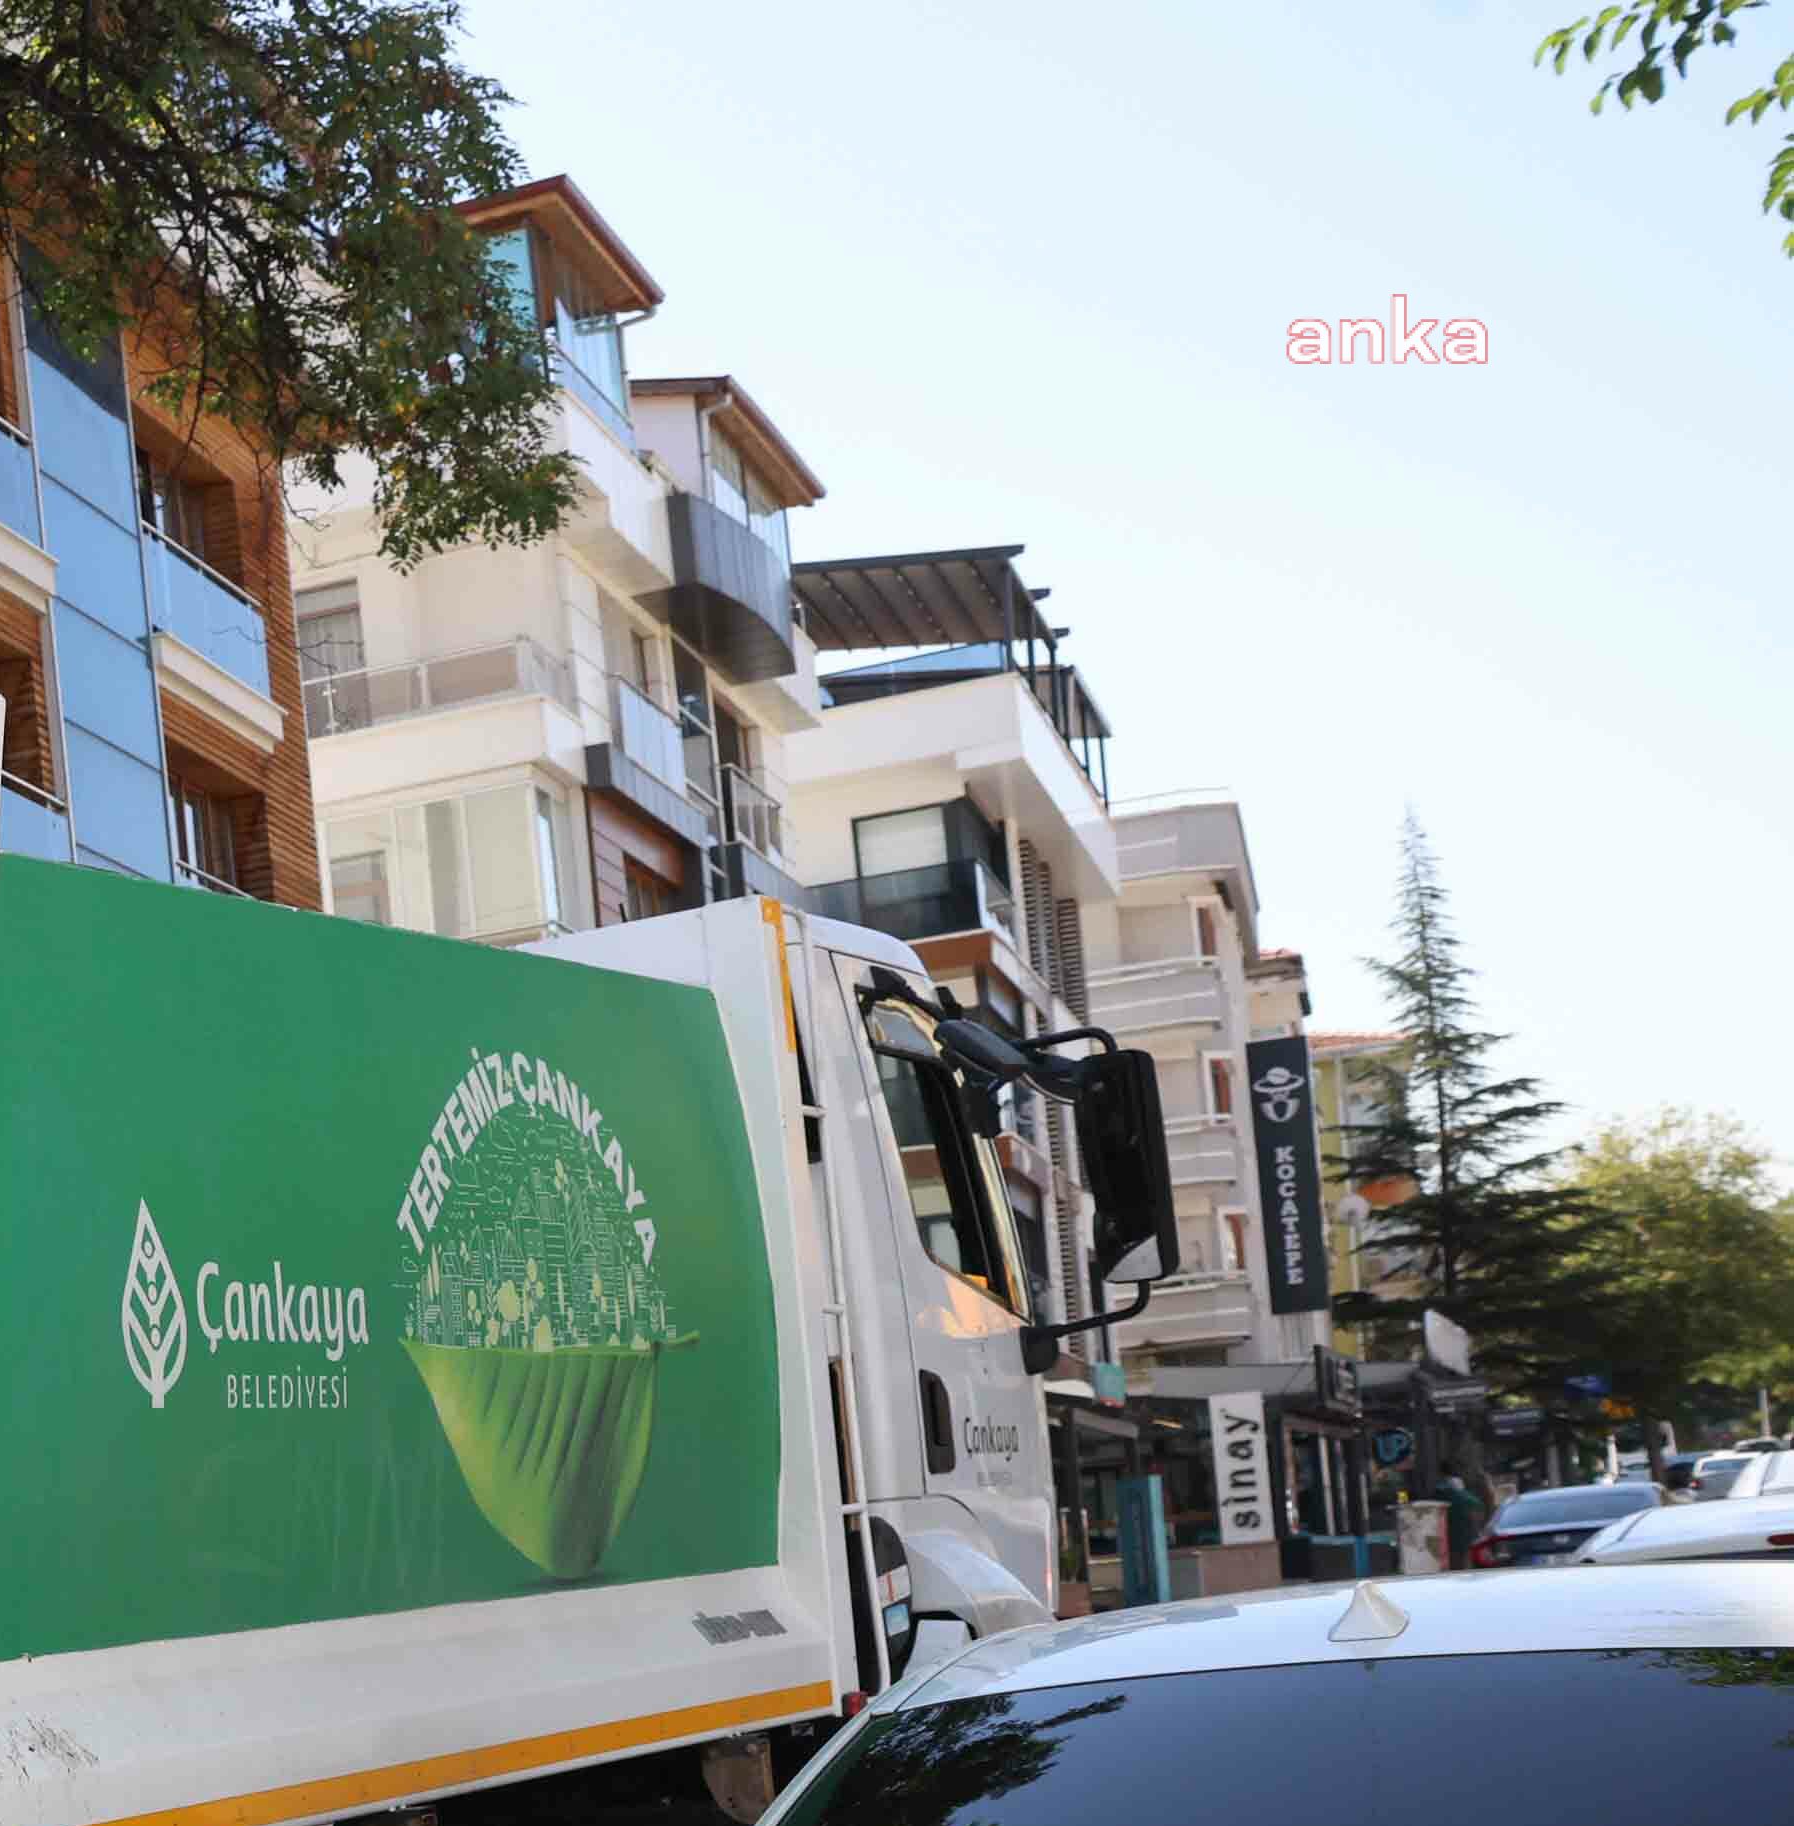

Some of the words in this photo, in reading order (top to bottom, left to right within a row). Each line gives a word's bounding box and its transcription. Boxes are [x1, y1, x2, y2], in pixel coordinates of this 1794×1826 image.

[396, 1047, 515, 1256] TERTEMİZ
[511, 1051, 657, 1267] ÇANKAYA
[1272, 1146, 1305, 1286] KOCATEPE
[196, 1260, 370, 1362] Çankaya
[227, 1364, 349, 1409] BELEDİYESİ
[963, 1415, 1021, 1463] Çankaya
